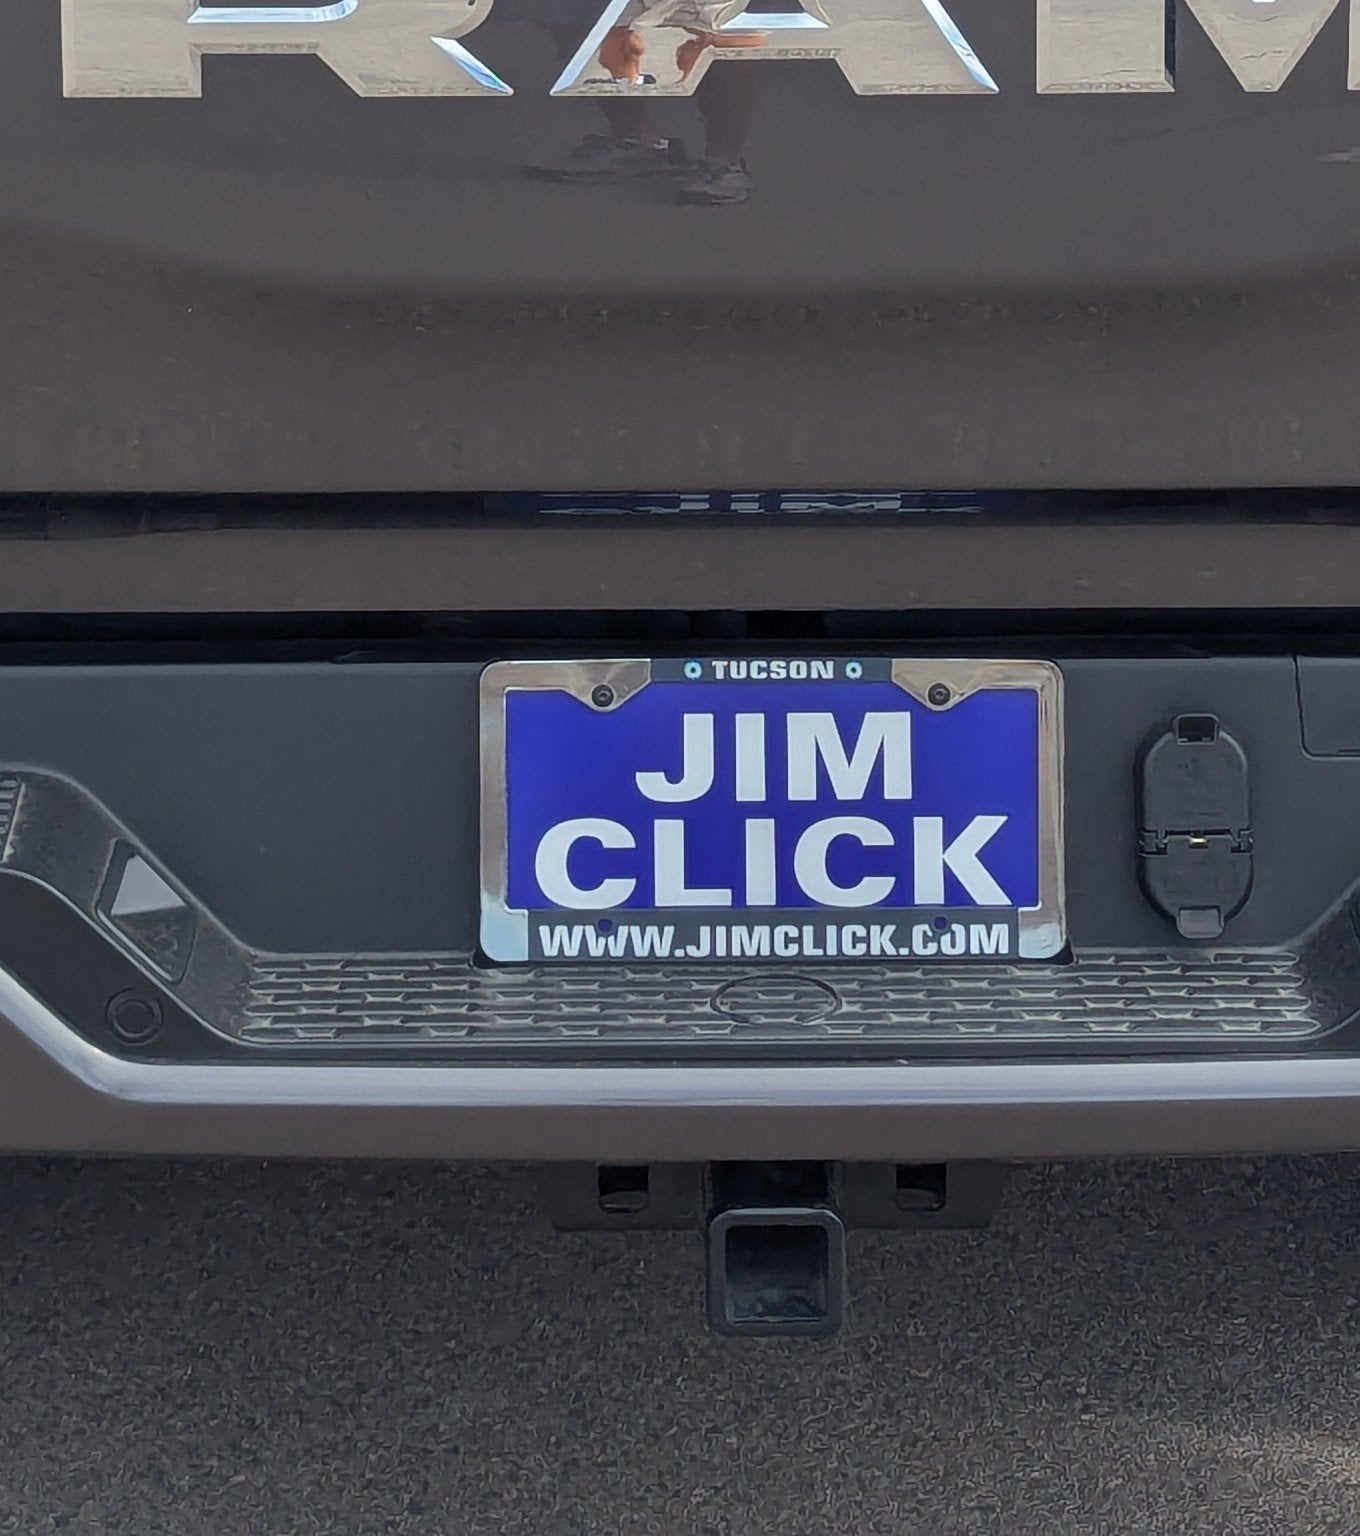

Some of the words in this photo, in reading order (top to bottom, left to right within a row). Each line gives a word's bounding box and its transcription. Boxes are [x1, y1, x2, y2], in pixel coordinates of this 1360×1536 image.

[711, 660, 834, 680] TUCSON
[635, 711, 913, 803] JIM
[535, 815, 1013, 909] CLICK
[539, 923, 1009, 958] WWW.JIMCLICK.COM
